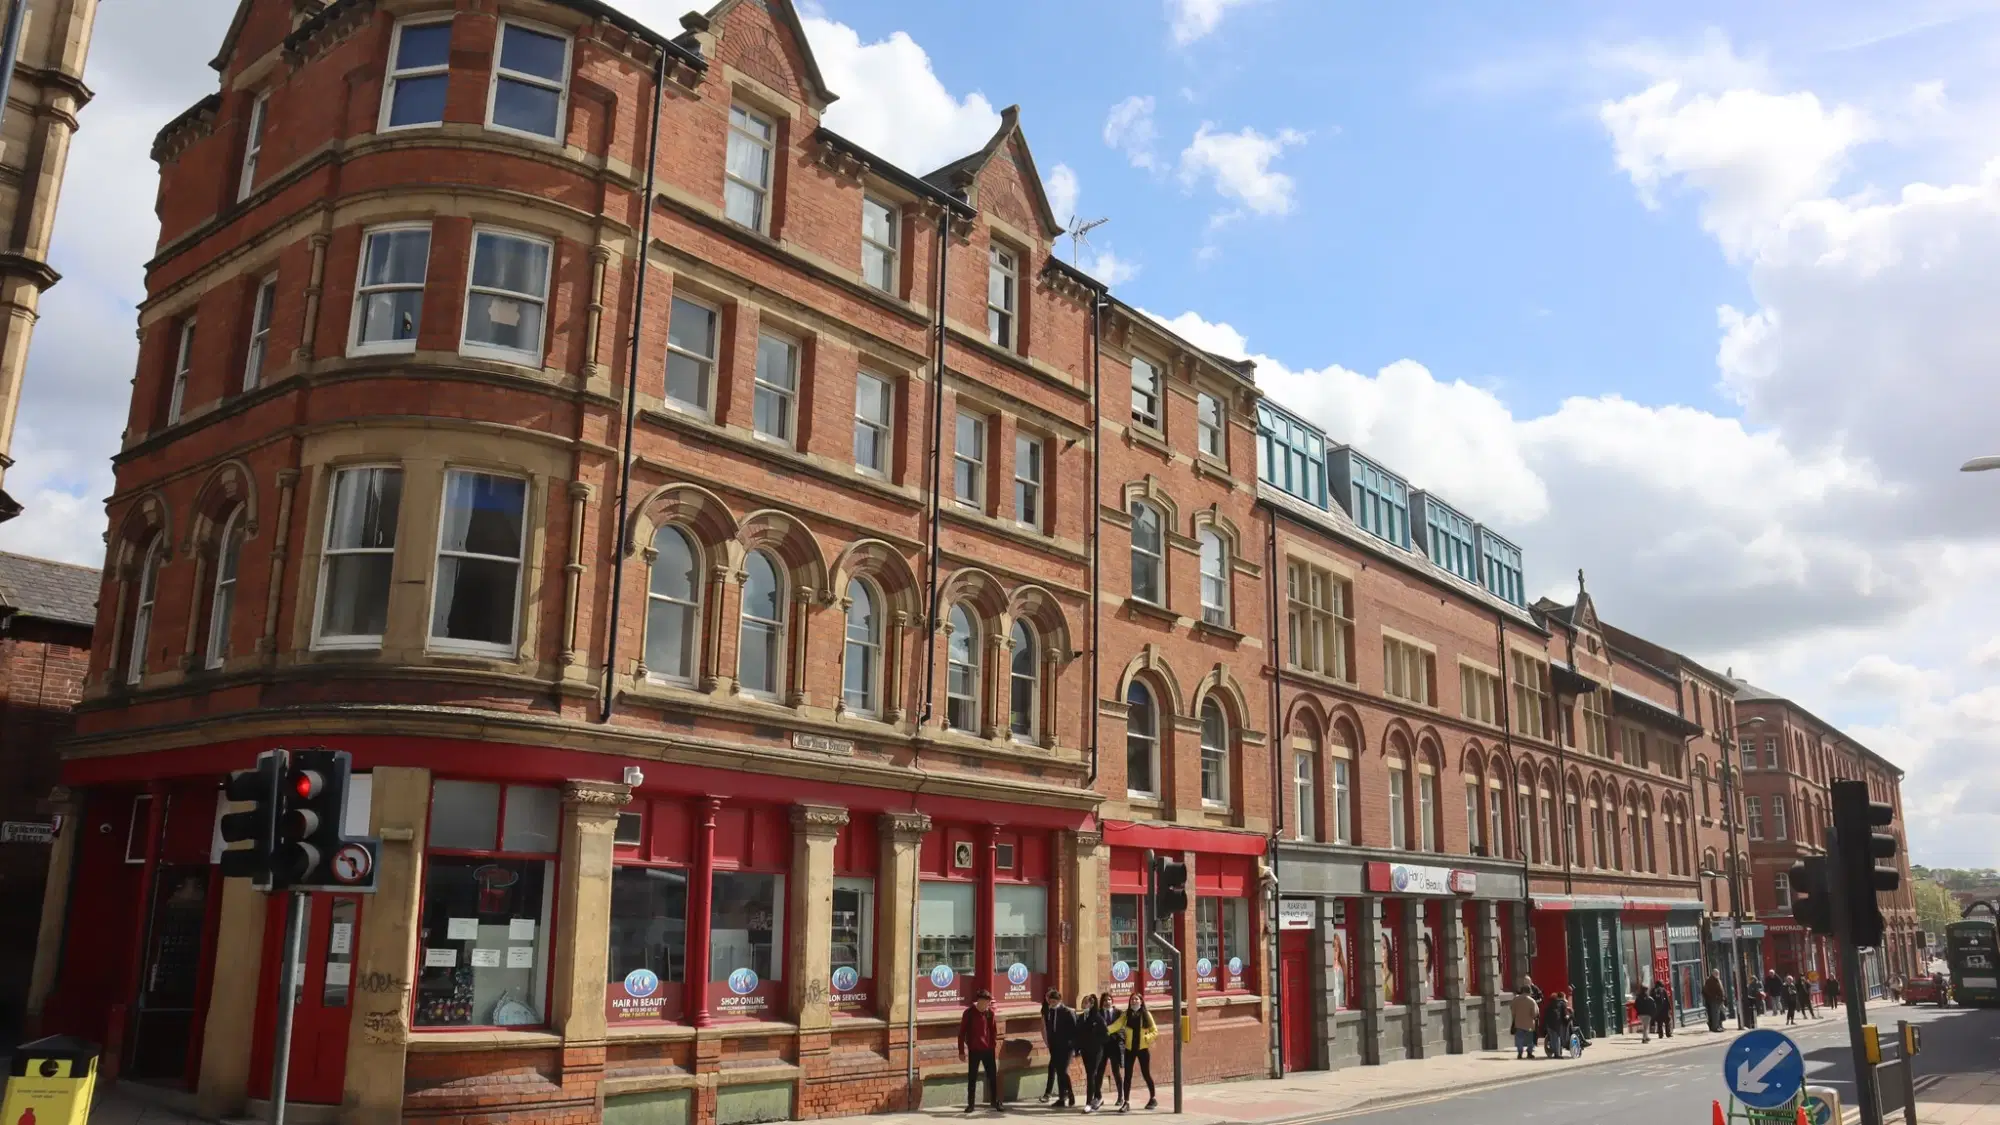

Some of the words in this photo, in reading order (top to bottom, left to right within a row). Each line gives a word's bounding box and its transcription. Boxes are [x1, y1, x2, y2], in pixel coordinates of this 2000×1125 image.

[1409, 870, 1420, 881] Hair
[1425, 878, 1444, 893] Beauty
[842, 993, 867, 1001] SERVICES
[939, 990, 957, 998] CENTRE
[612, 999, 631, 1007] HAIR
[640, 997, 667, 1006] BEAUTY
[740, 996, 765, 1004] ONLINE
